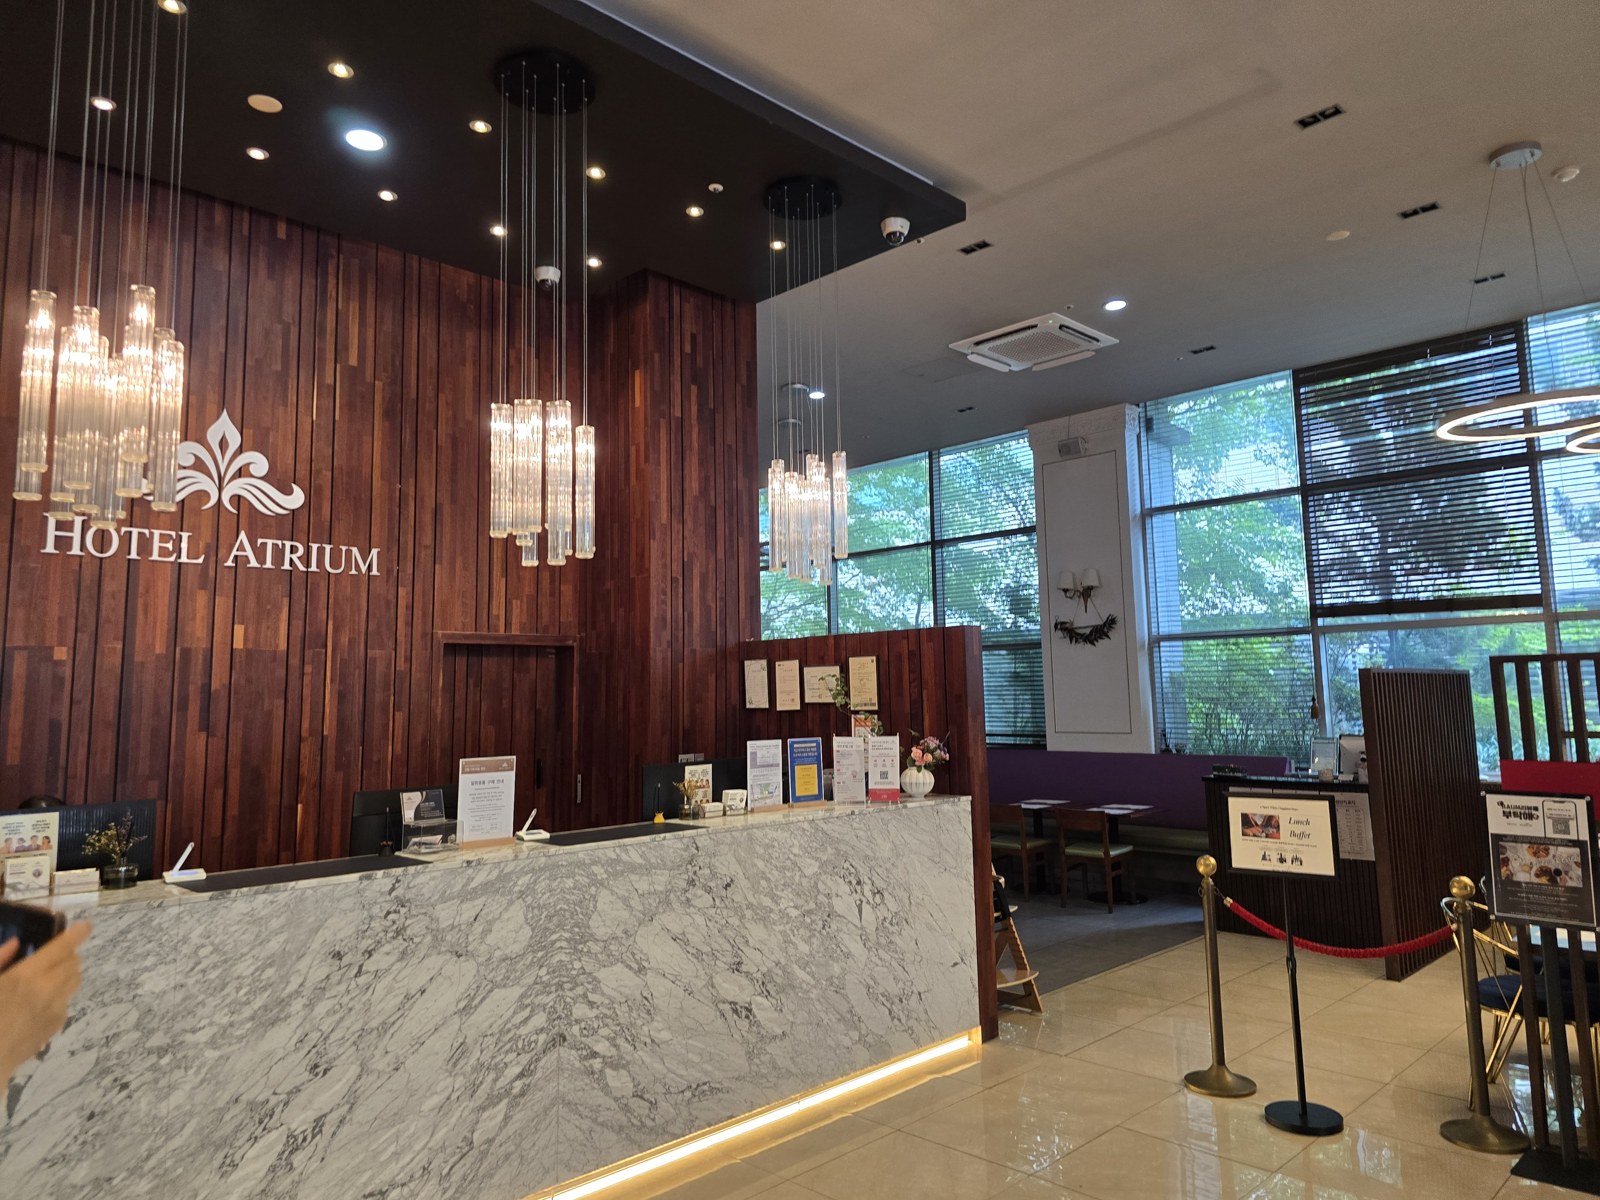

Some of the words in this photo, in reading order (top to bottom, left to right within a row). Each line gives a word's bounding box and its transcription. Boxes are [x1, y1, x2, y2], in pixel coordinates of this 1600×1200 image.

[40, 512, 205, 564] HOTEL
[224, 530, 381, 576] ATRIUM
[1288, 816, 1311, 826] Lunch
[1289, 830, 1311, 841] Buffet
